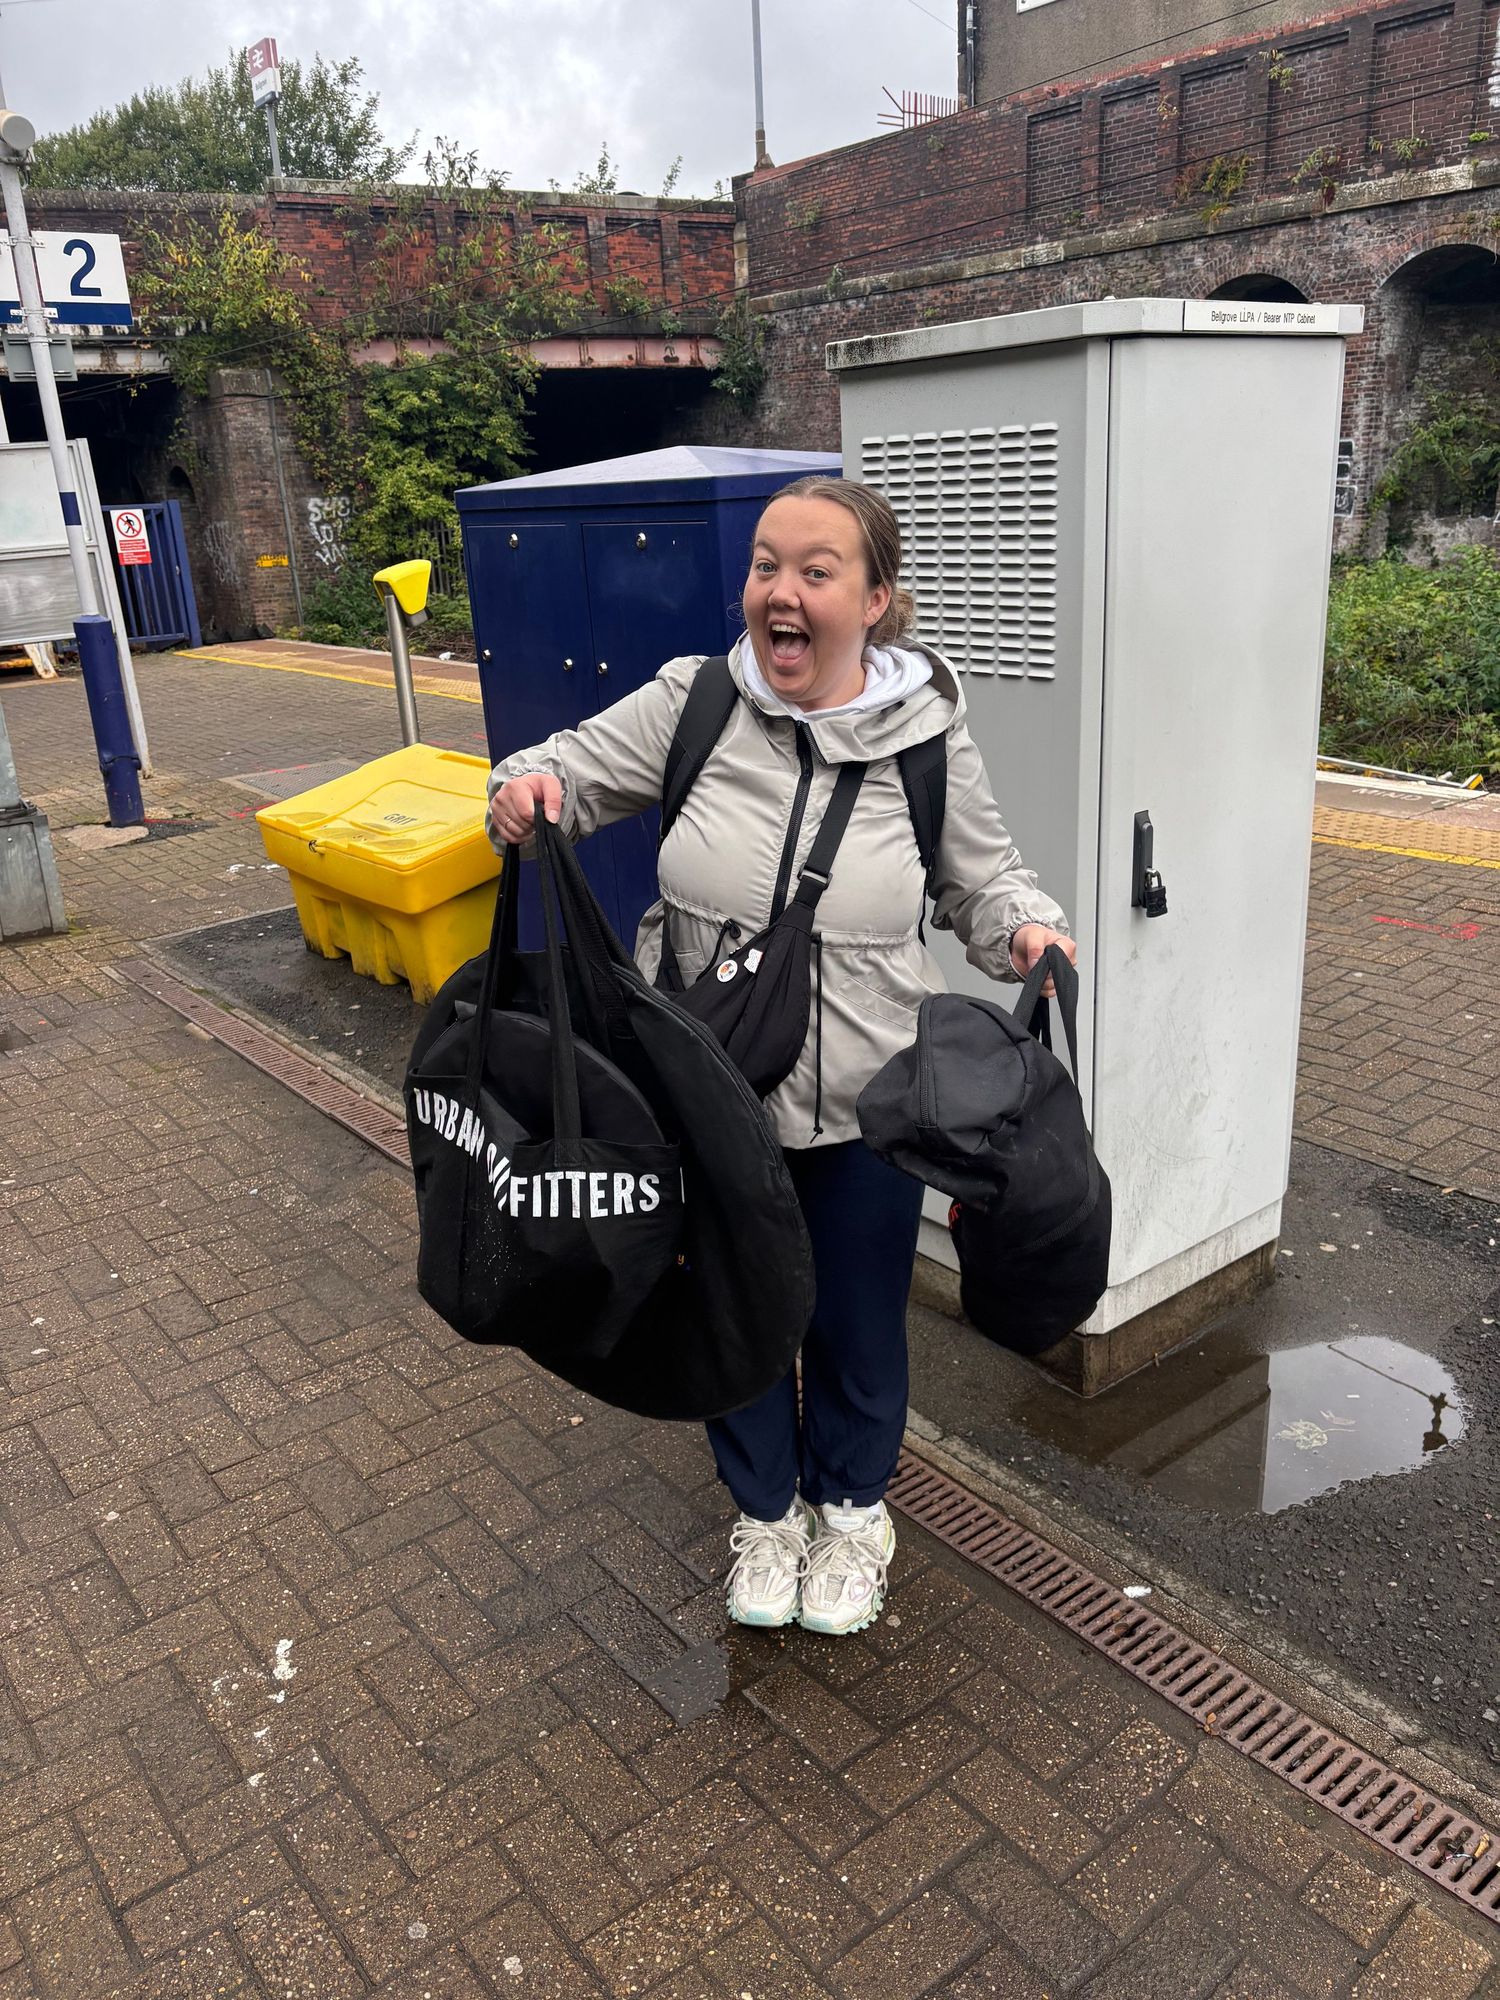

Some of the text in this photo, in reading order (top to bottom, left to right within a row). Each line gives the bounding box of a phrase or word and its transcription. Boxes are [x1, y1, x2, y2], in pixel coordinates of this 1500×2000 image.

[63, 238, 102, 297] 2
[1211, 310, 1237, 324] Bellgrove
[1264, 311, 1282, 323] Bearer
[1283, 312, 1295, 323] NTP
[1296, 313, 1316, 324] Cabinet
[1351, 787, 1423, 801] MIND
[383, 813, 418, 826] GRIT
[413, 1087, 486, 1164] URBAN
